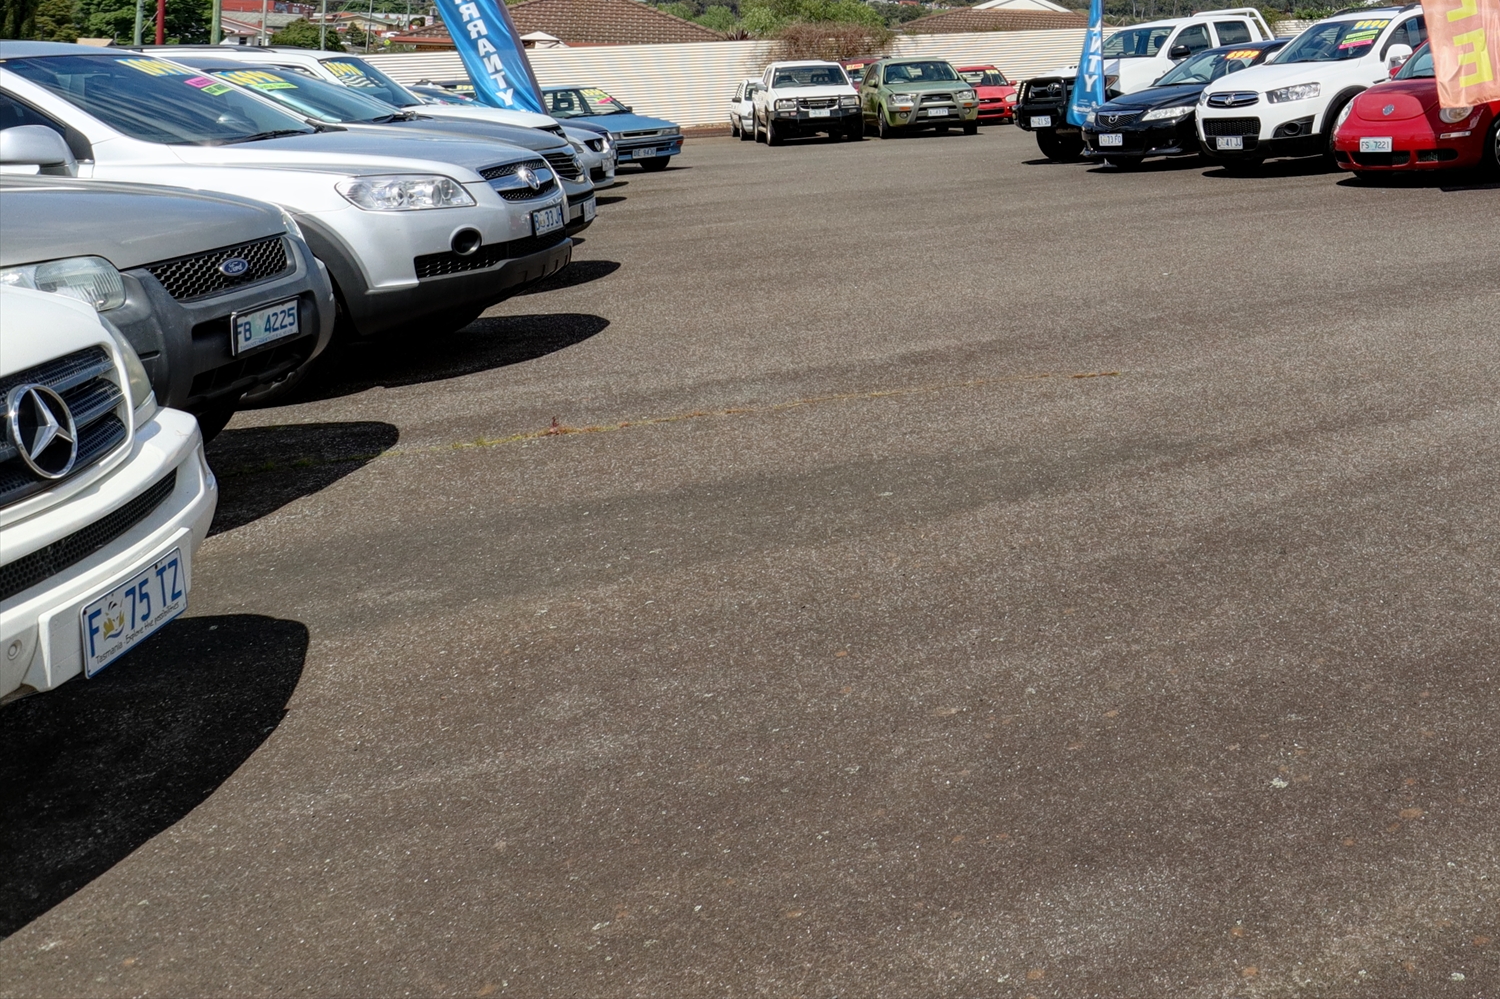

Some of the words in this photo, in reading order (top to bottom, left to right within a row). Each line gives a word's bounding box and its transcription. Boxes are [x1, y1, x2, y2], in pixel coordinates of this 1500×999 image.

[264, 306, 296, 334] 4225
[88, 608, 102, 658] F
[124, 578, 151, 630] 75
[156, 558, 182, 607] TZ
